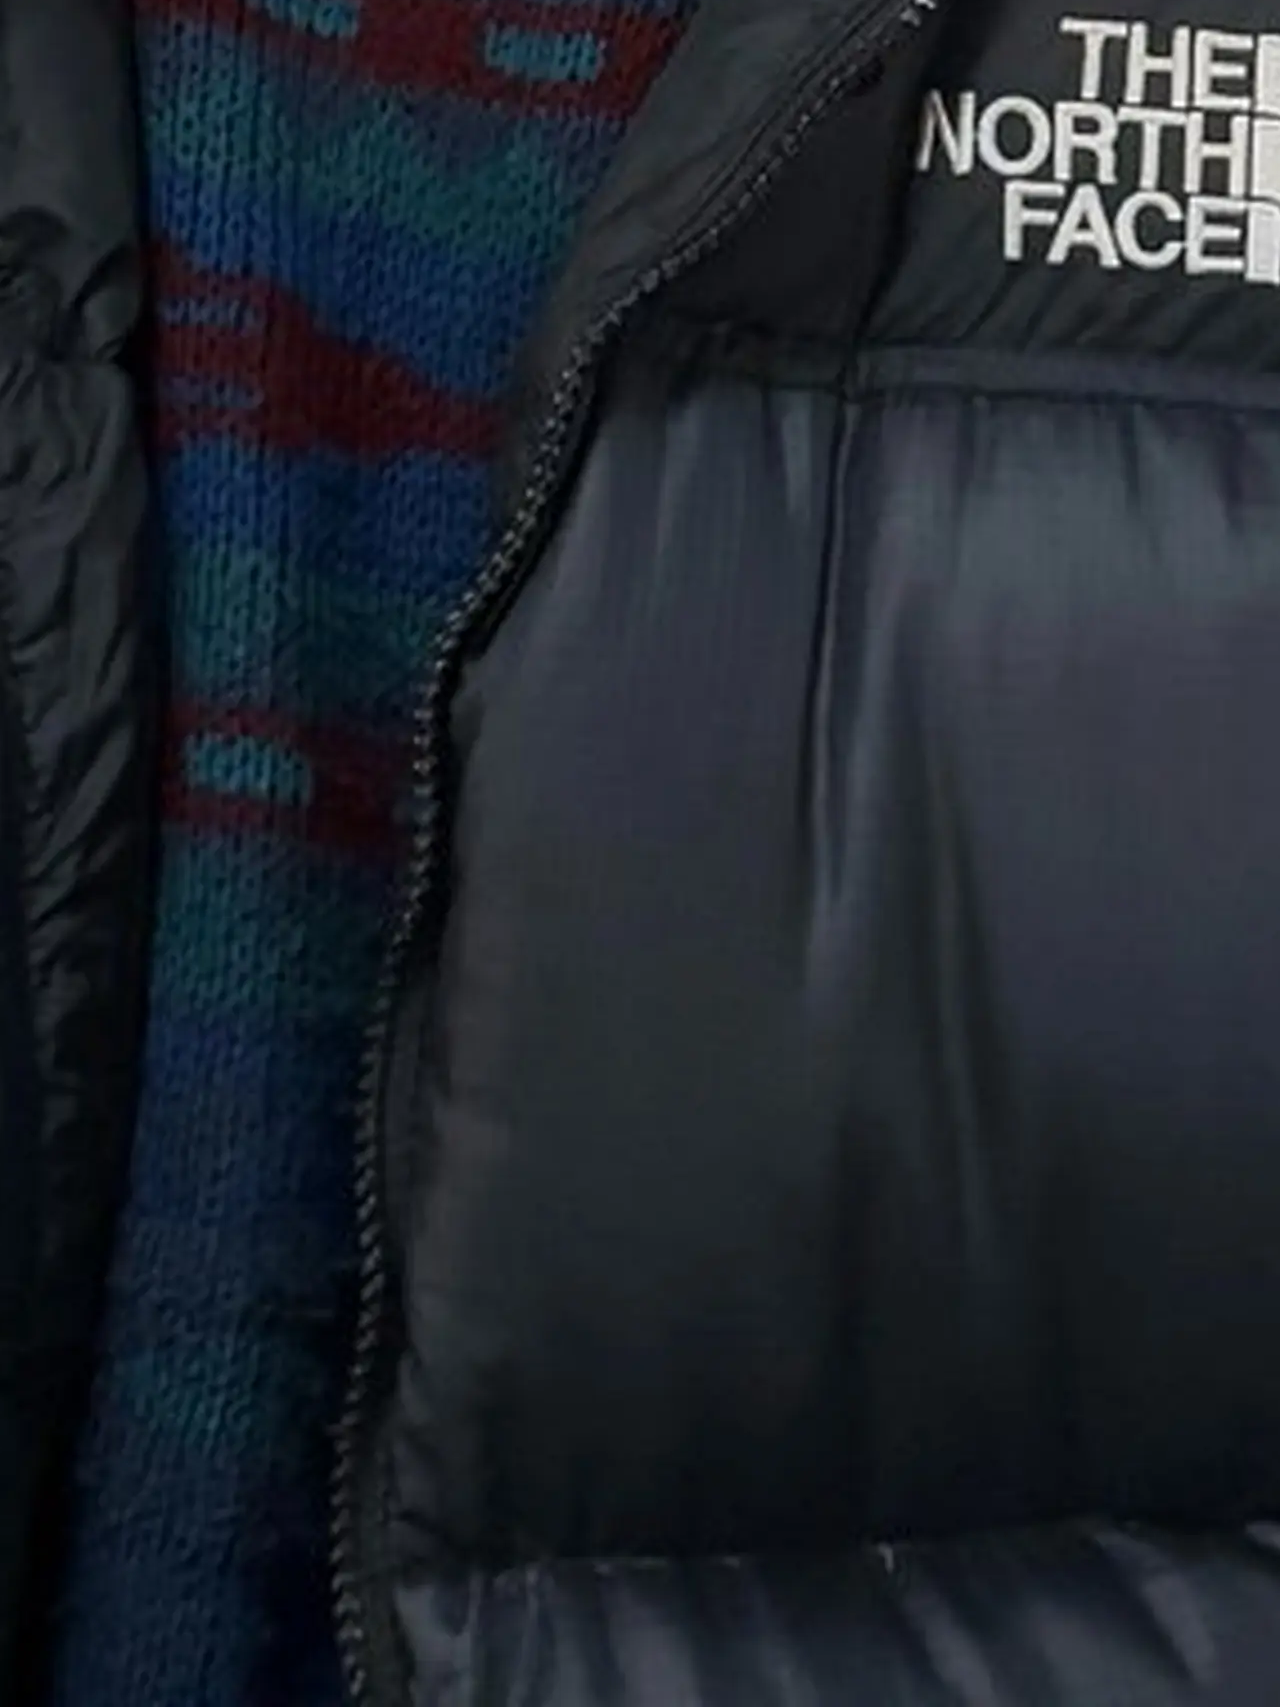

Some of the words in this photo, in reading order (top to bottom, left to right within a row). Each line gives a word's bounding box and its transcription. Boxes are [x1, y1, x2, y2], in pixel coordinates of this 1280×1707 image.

[1059, 16, 1253, 110] THE
[917, 89, 1250, 199] NORTH
[1003, 179, 1246, 275] FACE
